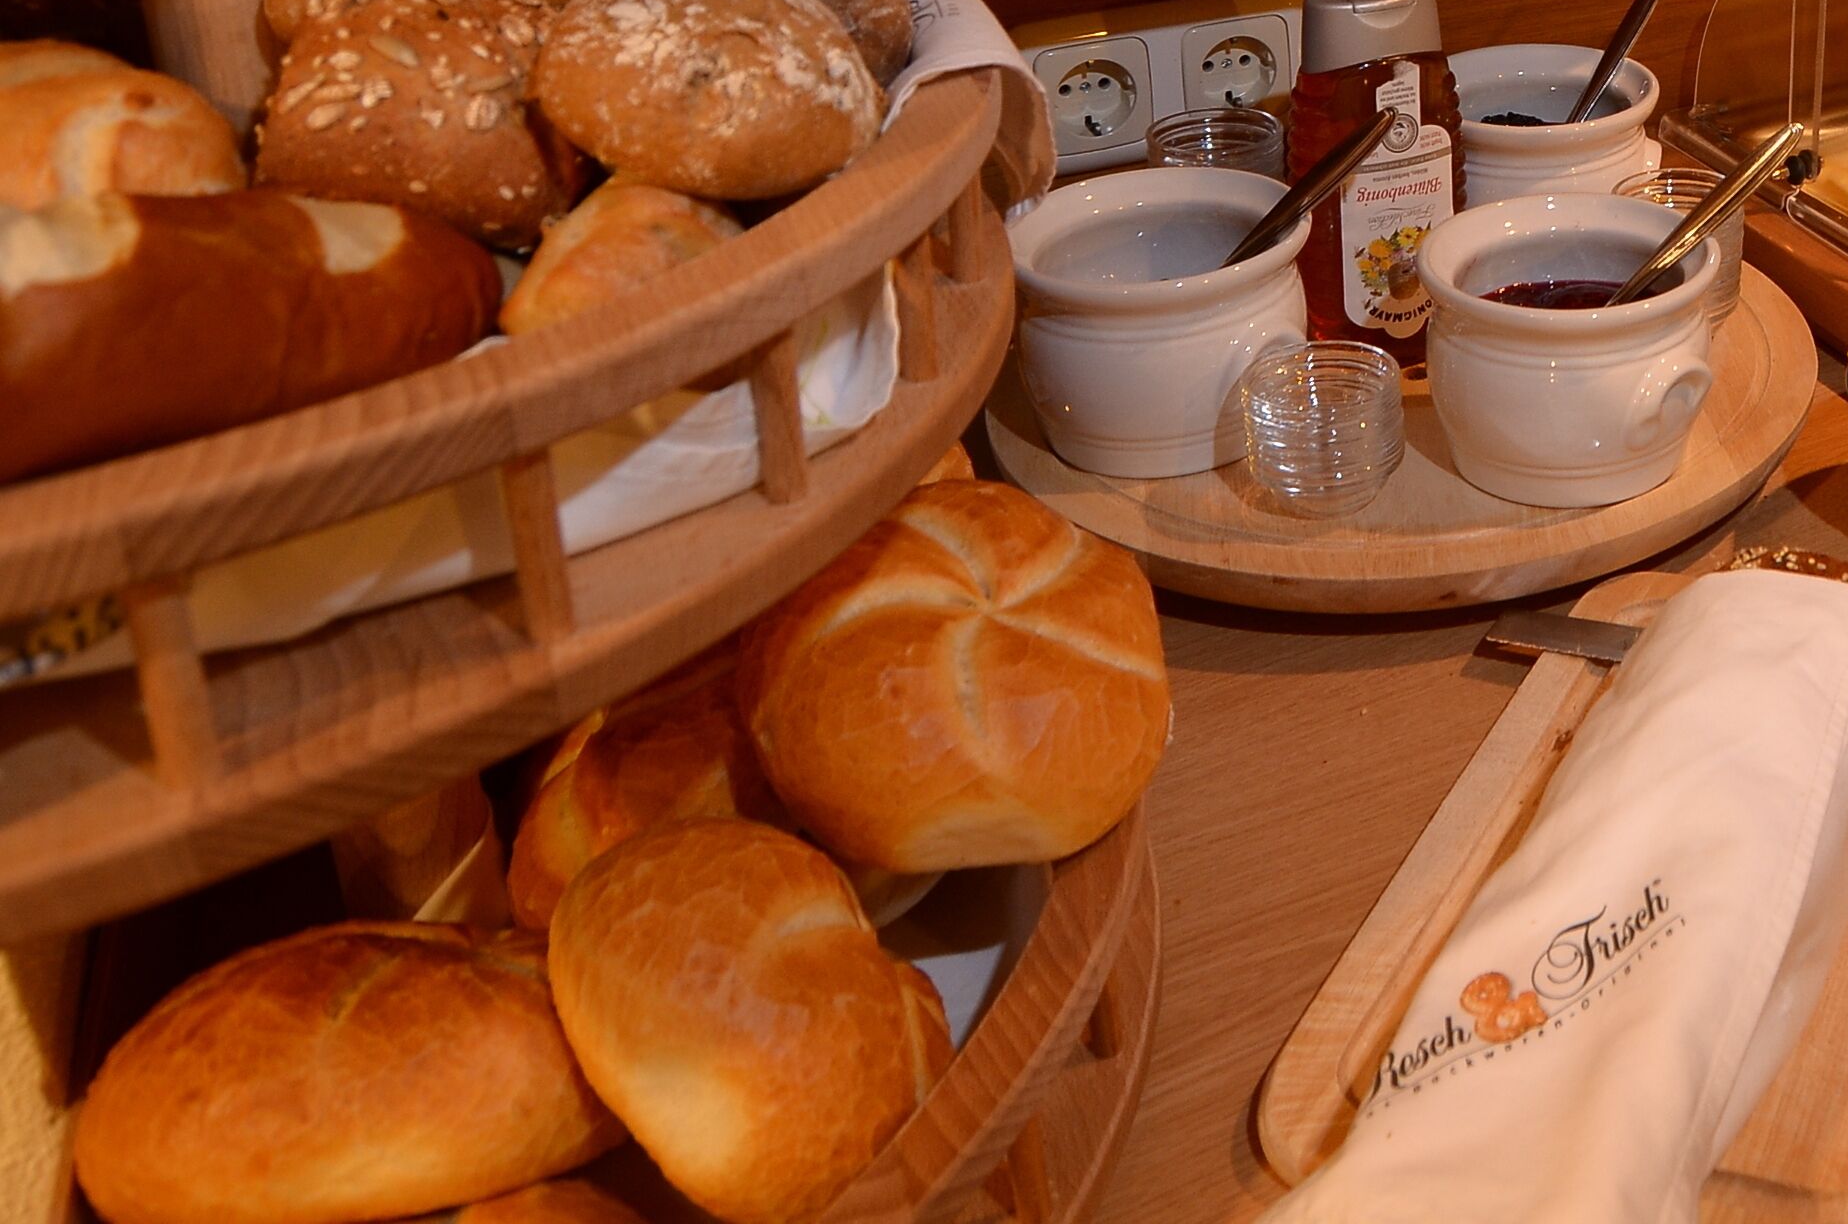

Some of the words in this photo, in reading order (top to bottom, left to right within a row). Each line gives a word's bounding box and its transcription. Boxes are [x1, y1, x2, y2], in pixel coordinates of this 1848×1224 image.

[1355, 176, 1442, 207] Blütenhonig
[1369, 296, 1434, 323] ONIGMAYR
[1531, 885, 1672, 1000] Frisch
